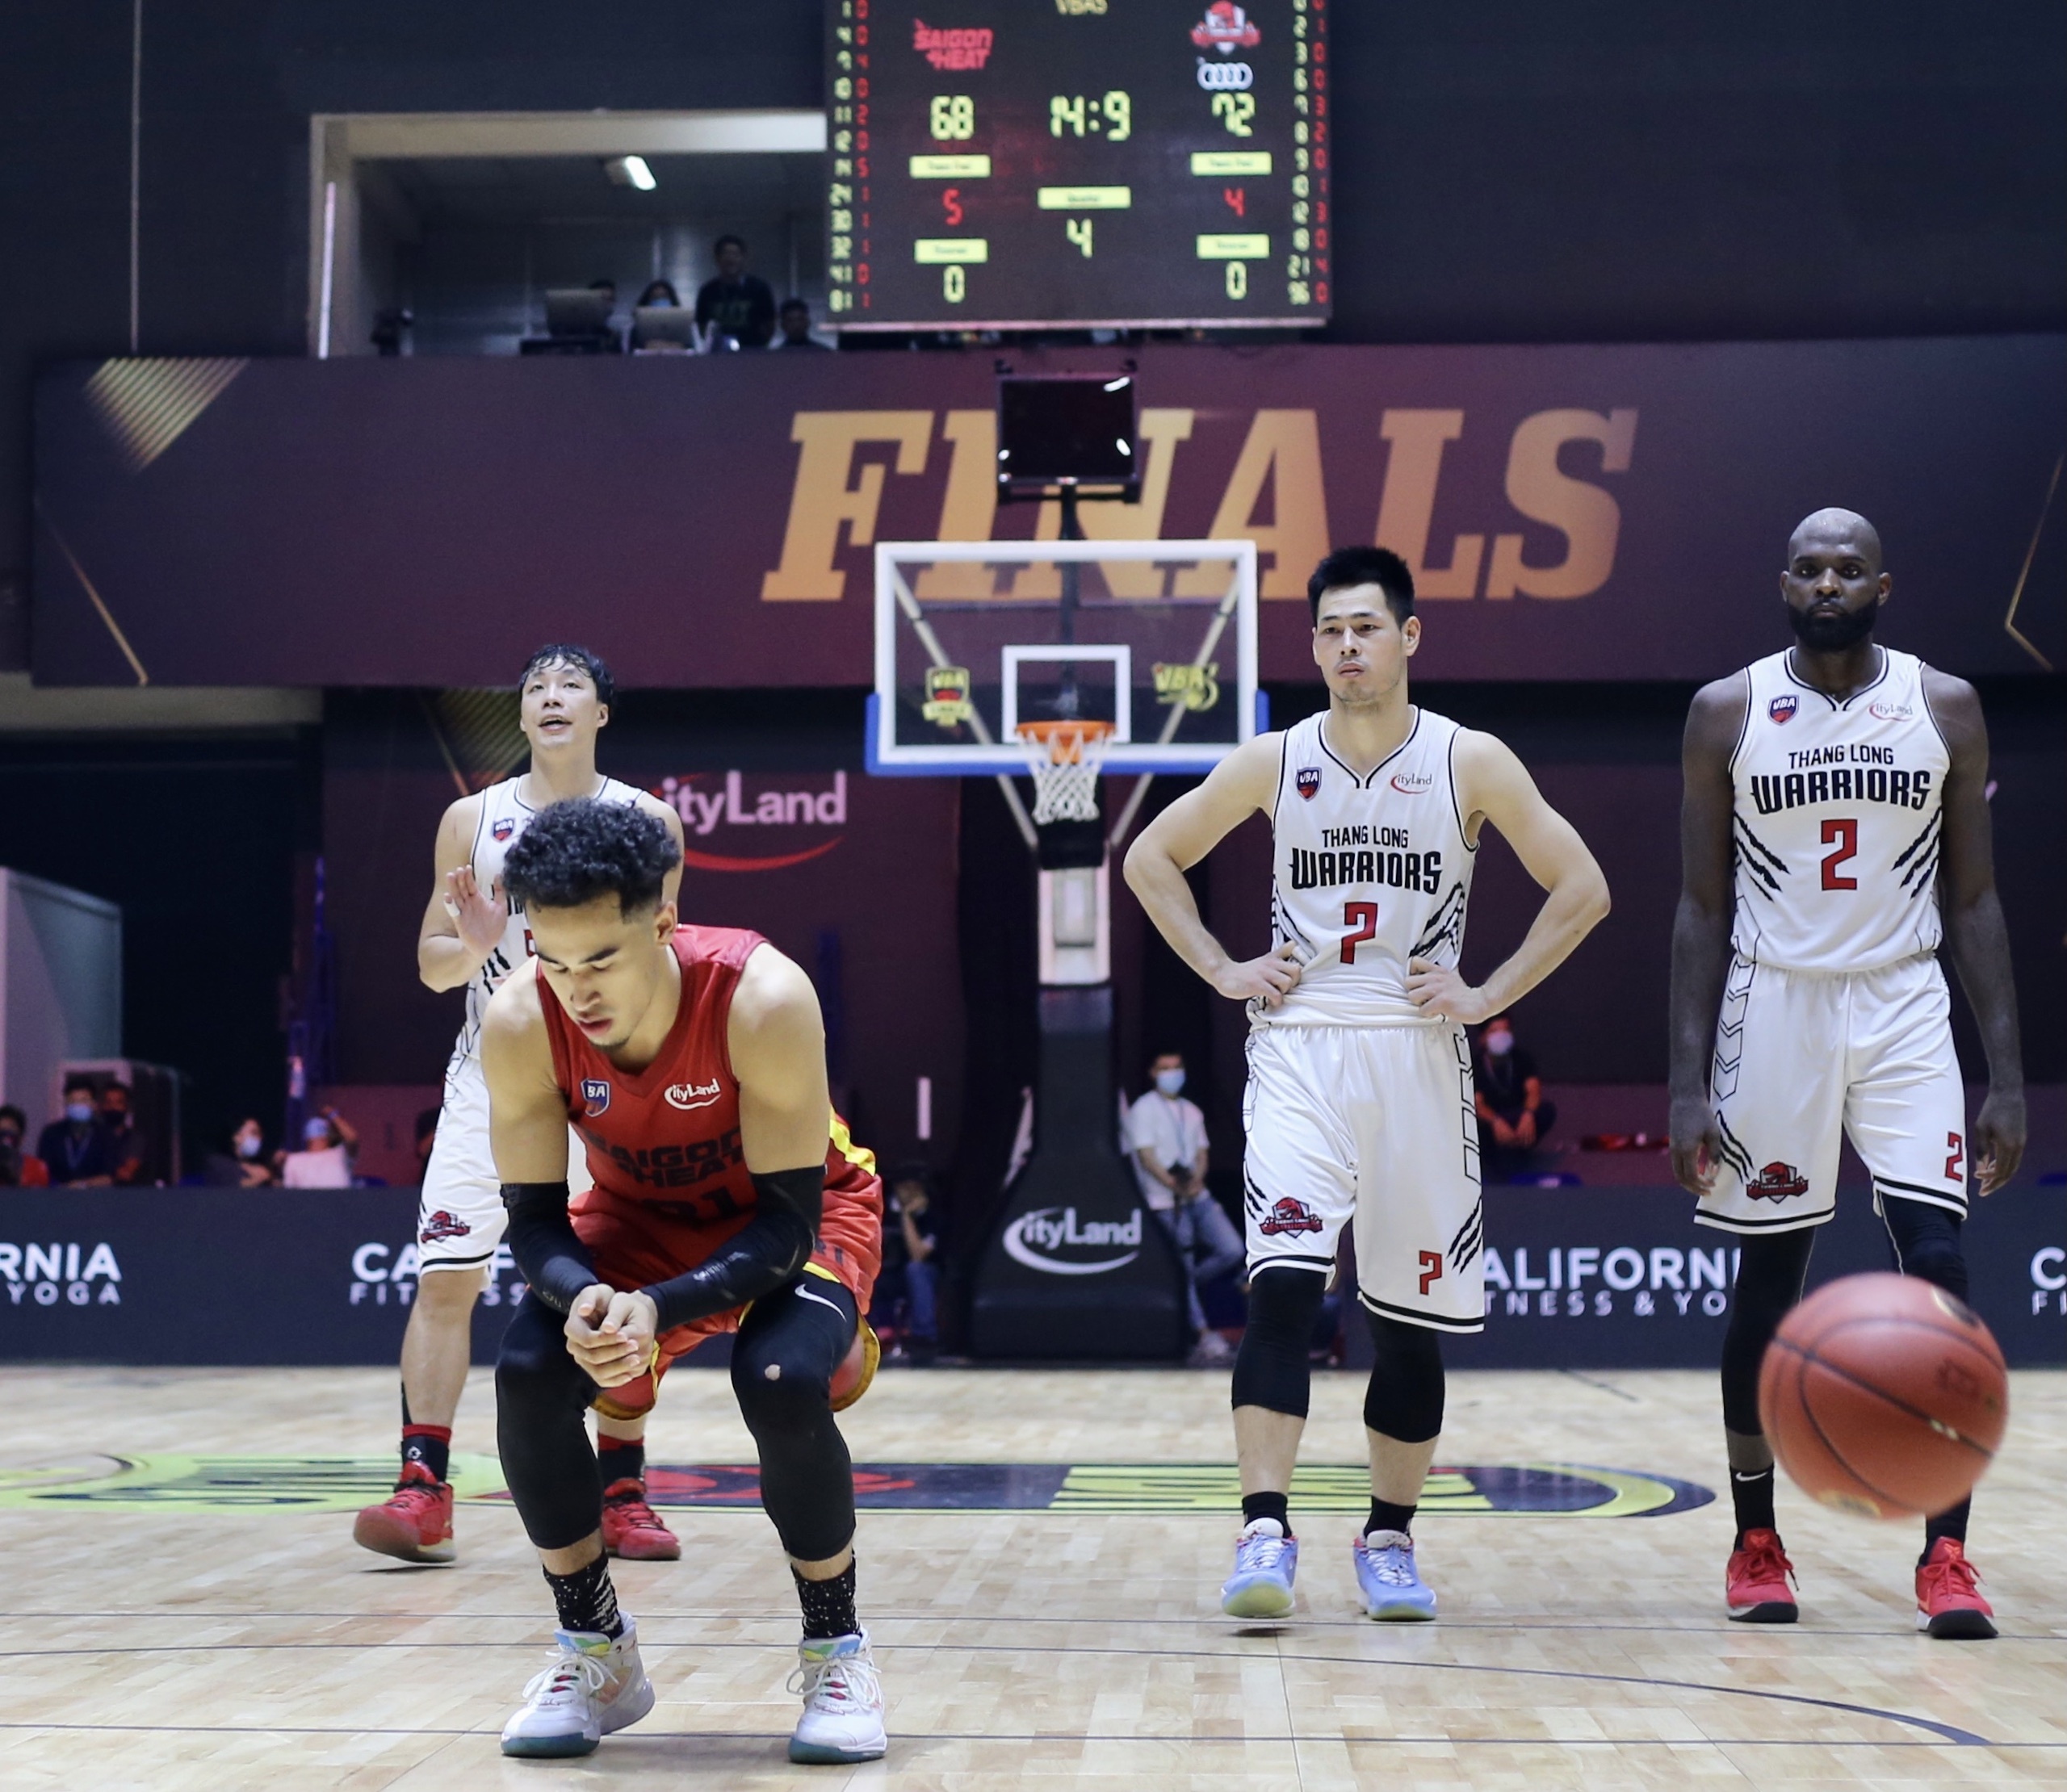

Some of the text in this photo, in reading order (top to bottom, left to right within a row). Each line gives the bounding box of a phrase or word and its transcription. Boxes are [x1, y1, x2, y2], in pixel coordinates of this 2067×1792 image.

[834, 106, 852, 123] 11
[930, 95, 974, 140] 68
[1050, 90, 1130, 141] 14:9
[1212, 92, 1256, 137] 72
[942, 189, 963, 225] 5
[1224, 187, 1245, 216] 4
[1066, 219, 1093, 257] 4
[943, 265, 965, 303] 0
[1226, 261, 1247, 299] 0
[761, 408, 1638, 601] FINALS
[1772, 697, 1796, 710] VBA
[1788, 744, 1893, 768] THANG LONG
[1750, 768, 1931, 814] WARRIORS
[1322, 826, 1409, 848] THANG LONG
[1821, 819, 1857, 891] 2
[1289, 848, 1443, 895] WARRIORS
[1945, 1132, 1963, 1182] 2
[1002, 1206, 1143, 1275] CityLand
[2031, 1246, 2067, 1291] C
[6, 1281, 121, 1305] YOGA
[1633, 1290, 1655, 1317] &
[1674, 1290, 1727, 1317] YO
